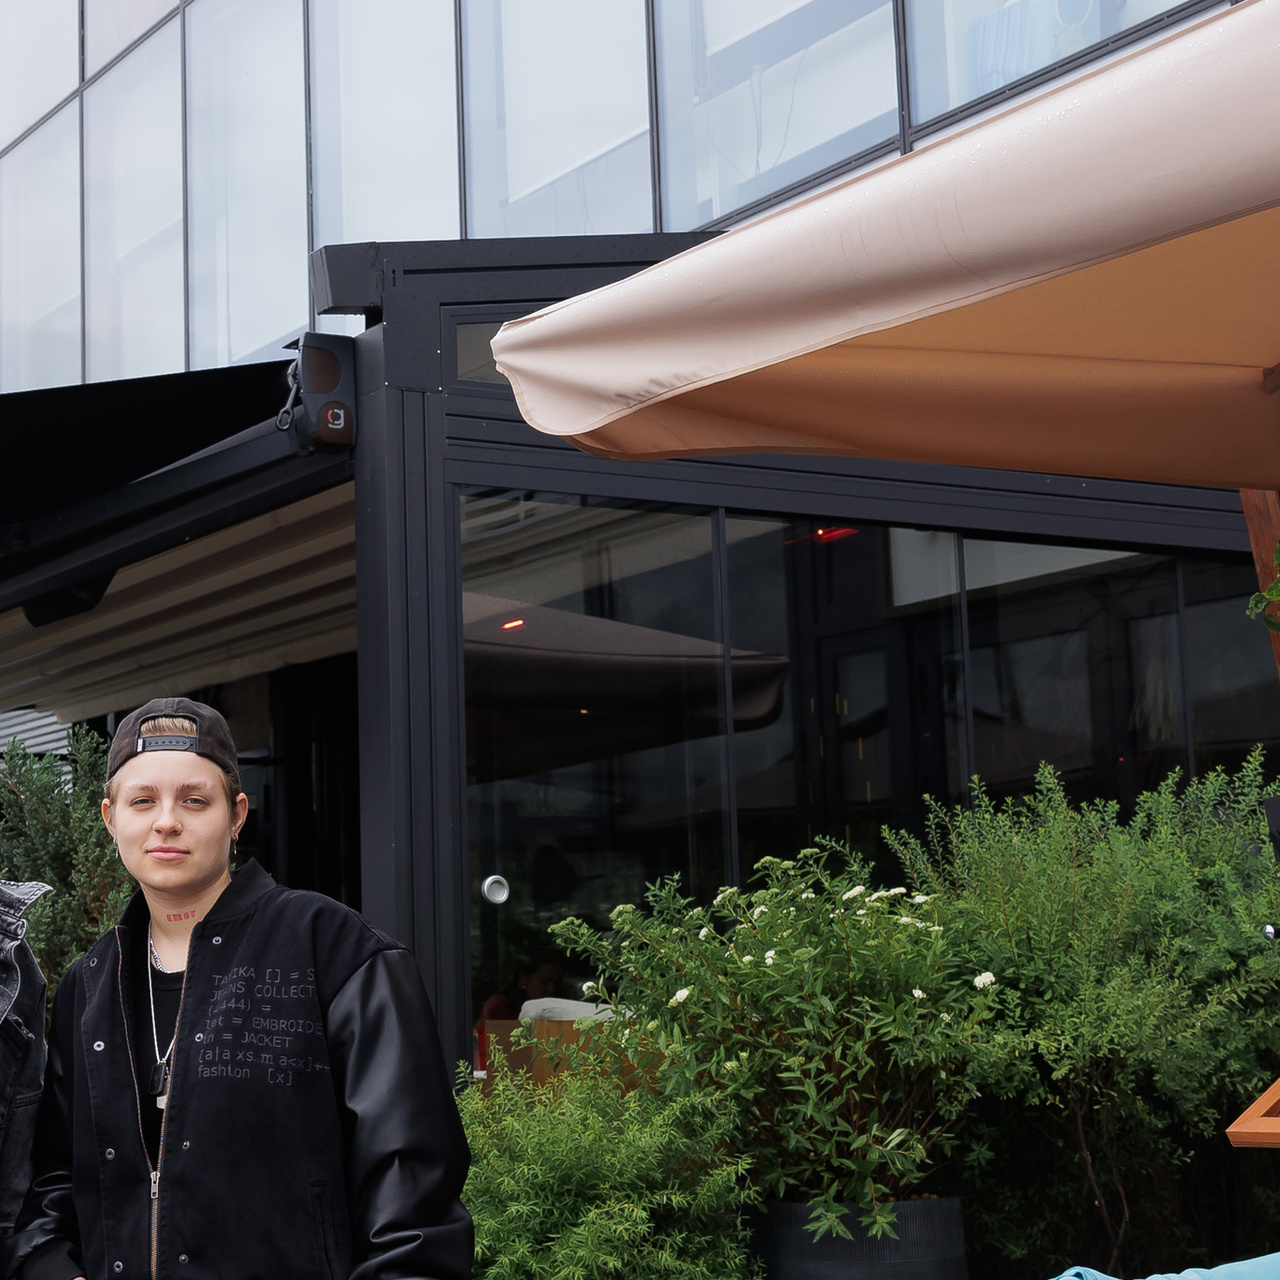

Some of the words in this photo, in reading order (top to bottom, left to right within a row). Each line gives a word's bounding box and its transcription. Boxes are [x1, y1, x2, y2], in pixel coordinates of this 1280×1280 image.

[254, 984, 317, 999] COLLECT
[241, 1032, 293, 1049] JACKET
[197, 1062, 251, 1079] fashion
